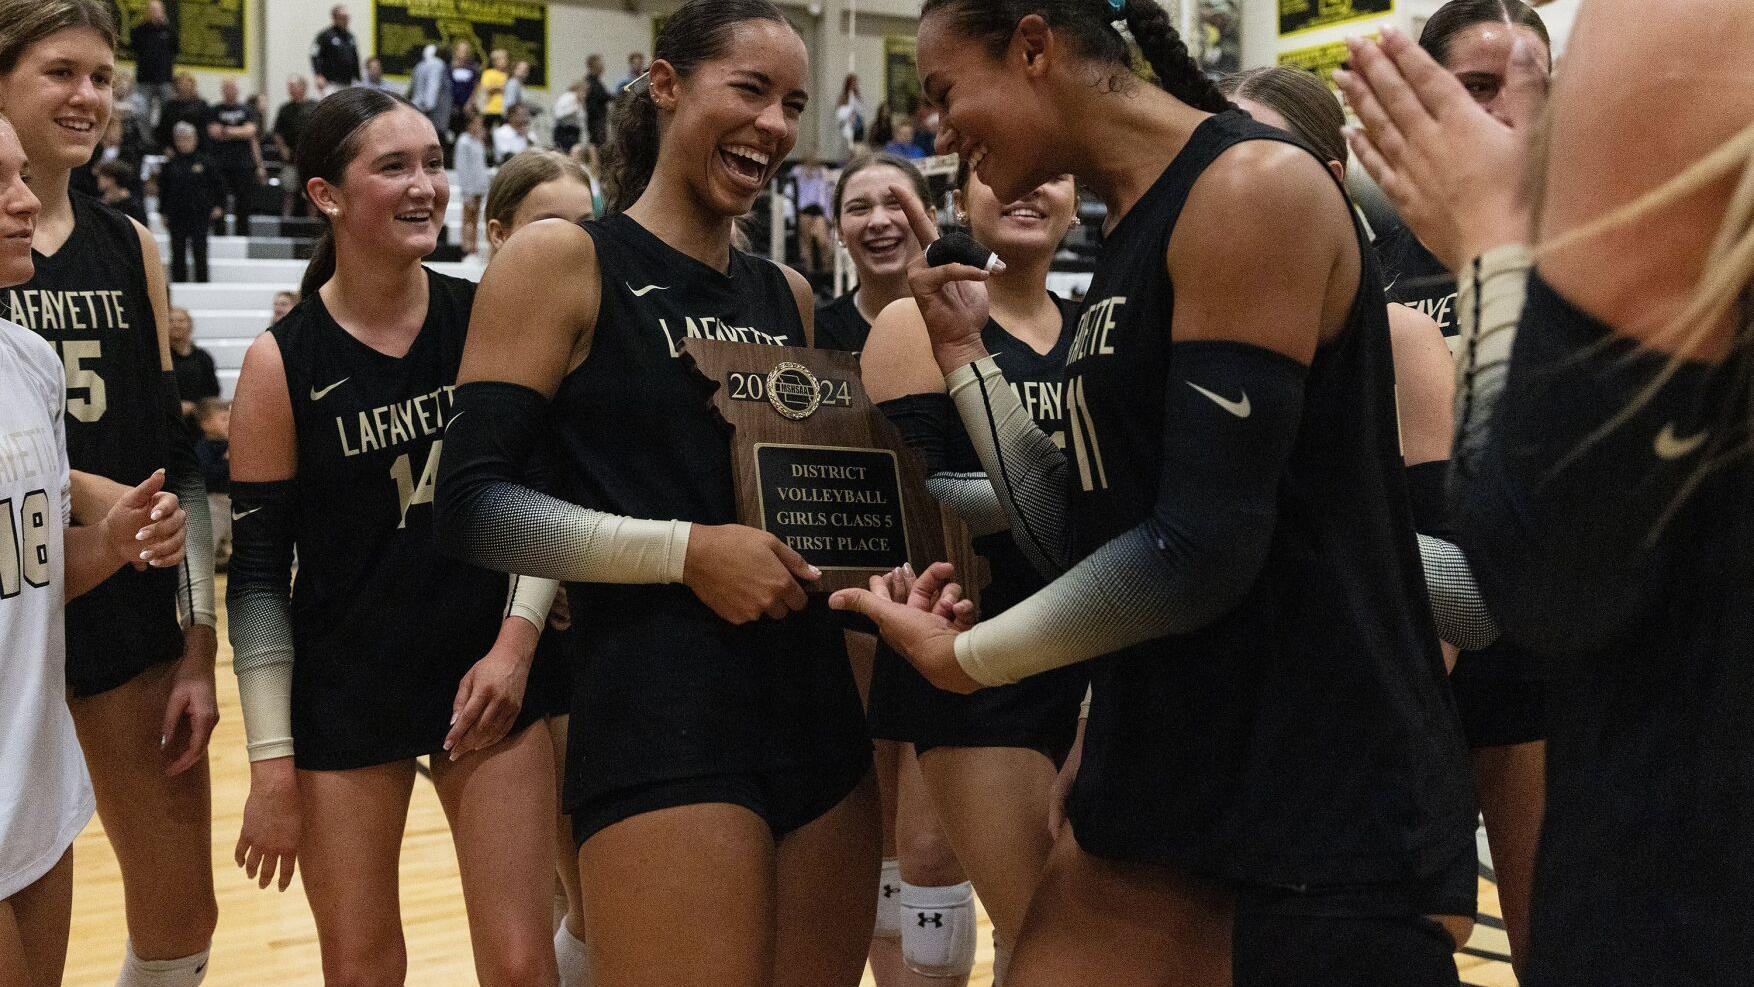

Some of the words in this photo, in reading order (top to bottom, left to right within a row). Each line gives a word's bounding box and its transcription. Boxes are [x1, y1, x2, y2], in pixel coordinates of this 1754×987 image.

[48, 340, 107, 422] 5
[730, 372, 763, 400] 20
[820, 379, 852, 406] 24
[780, 383, 809, 396] MSHSAA
[1066, 374, 1108, 491] 11
[389, 439, 444, 529] 14
[790, 463, 866, 480] DISTRICT
[776, 487, 887, 504] VOLLEYBALL
[776, 511, 827, 526] GIRLS
[830, 512, 881, 528] CLASS
[884, 515, 893, 528] 5
[0, 488, 50, 599] 18
[786, 535, 833, 551] FIRST
[837, 536, 890, 552] PLACE
